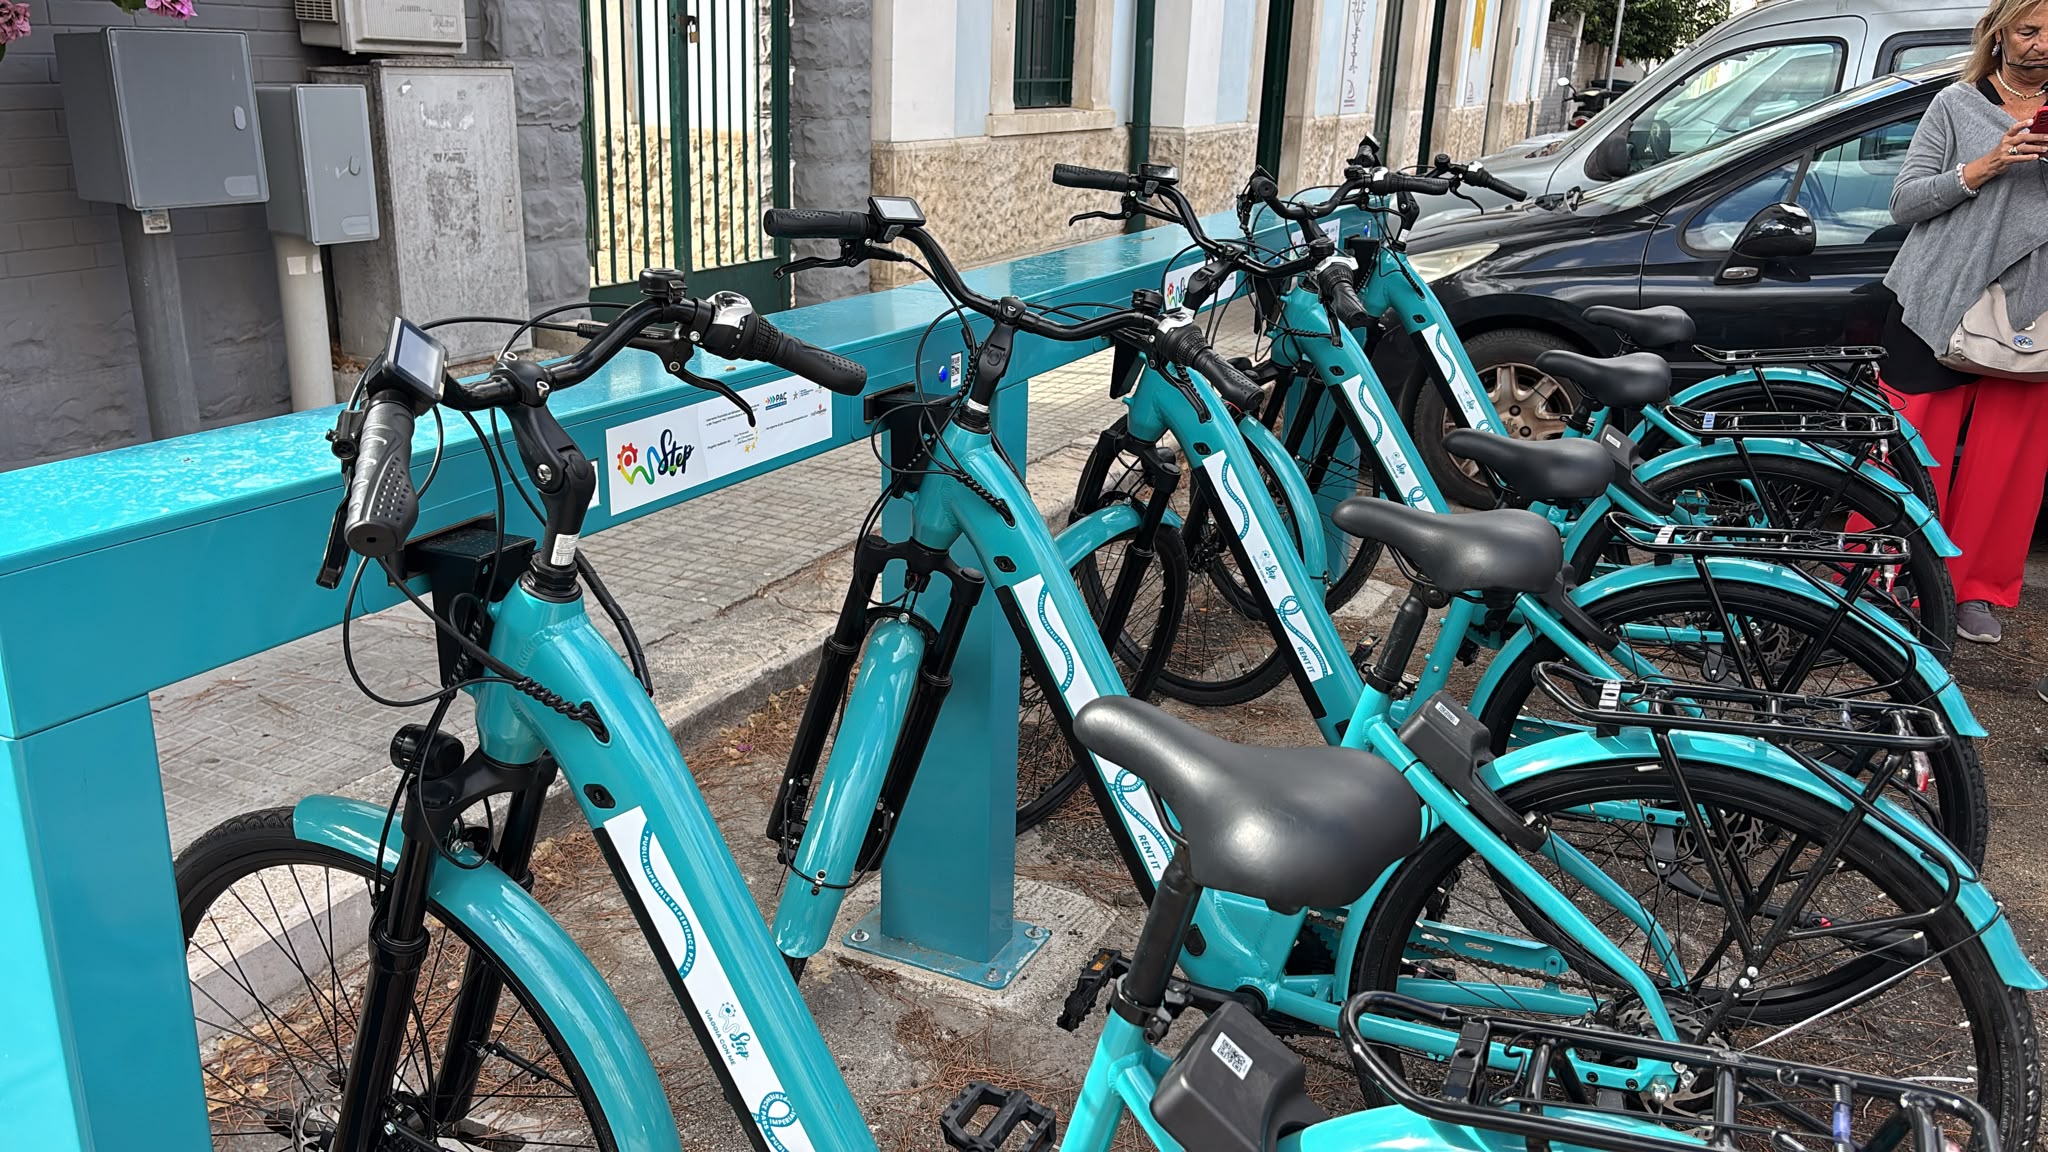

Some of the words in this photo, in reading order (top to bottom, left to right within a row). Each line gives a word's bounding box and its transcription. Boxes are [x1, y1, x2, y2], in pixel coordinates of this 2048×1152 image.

[775, 391, 788, 402] PAC
[658, 429, 694, 477] Step
[1265, 564, 1278, 580] Step
[1297, 646, 1311, 665] RENT
[1306, 665, 1316, 673] IT
[641, 835, 649, 864] PUGLIA
[1138, 834, 1156, 860] RENT
[1150, 860, 1162, 871] IT
[644, 865, 670, 902] IMPERIALE
[669, 901, 694, 950] EXPERIENCE
[684, 952, 694, 972] PASS
[704, 1008, 722, 1039] VIAGGIA
[719, 1038, 731, 1055] CON
[727, 1054, 737, 1066] ME
[729, 1031, 751, 1061] Step
